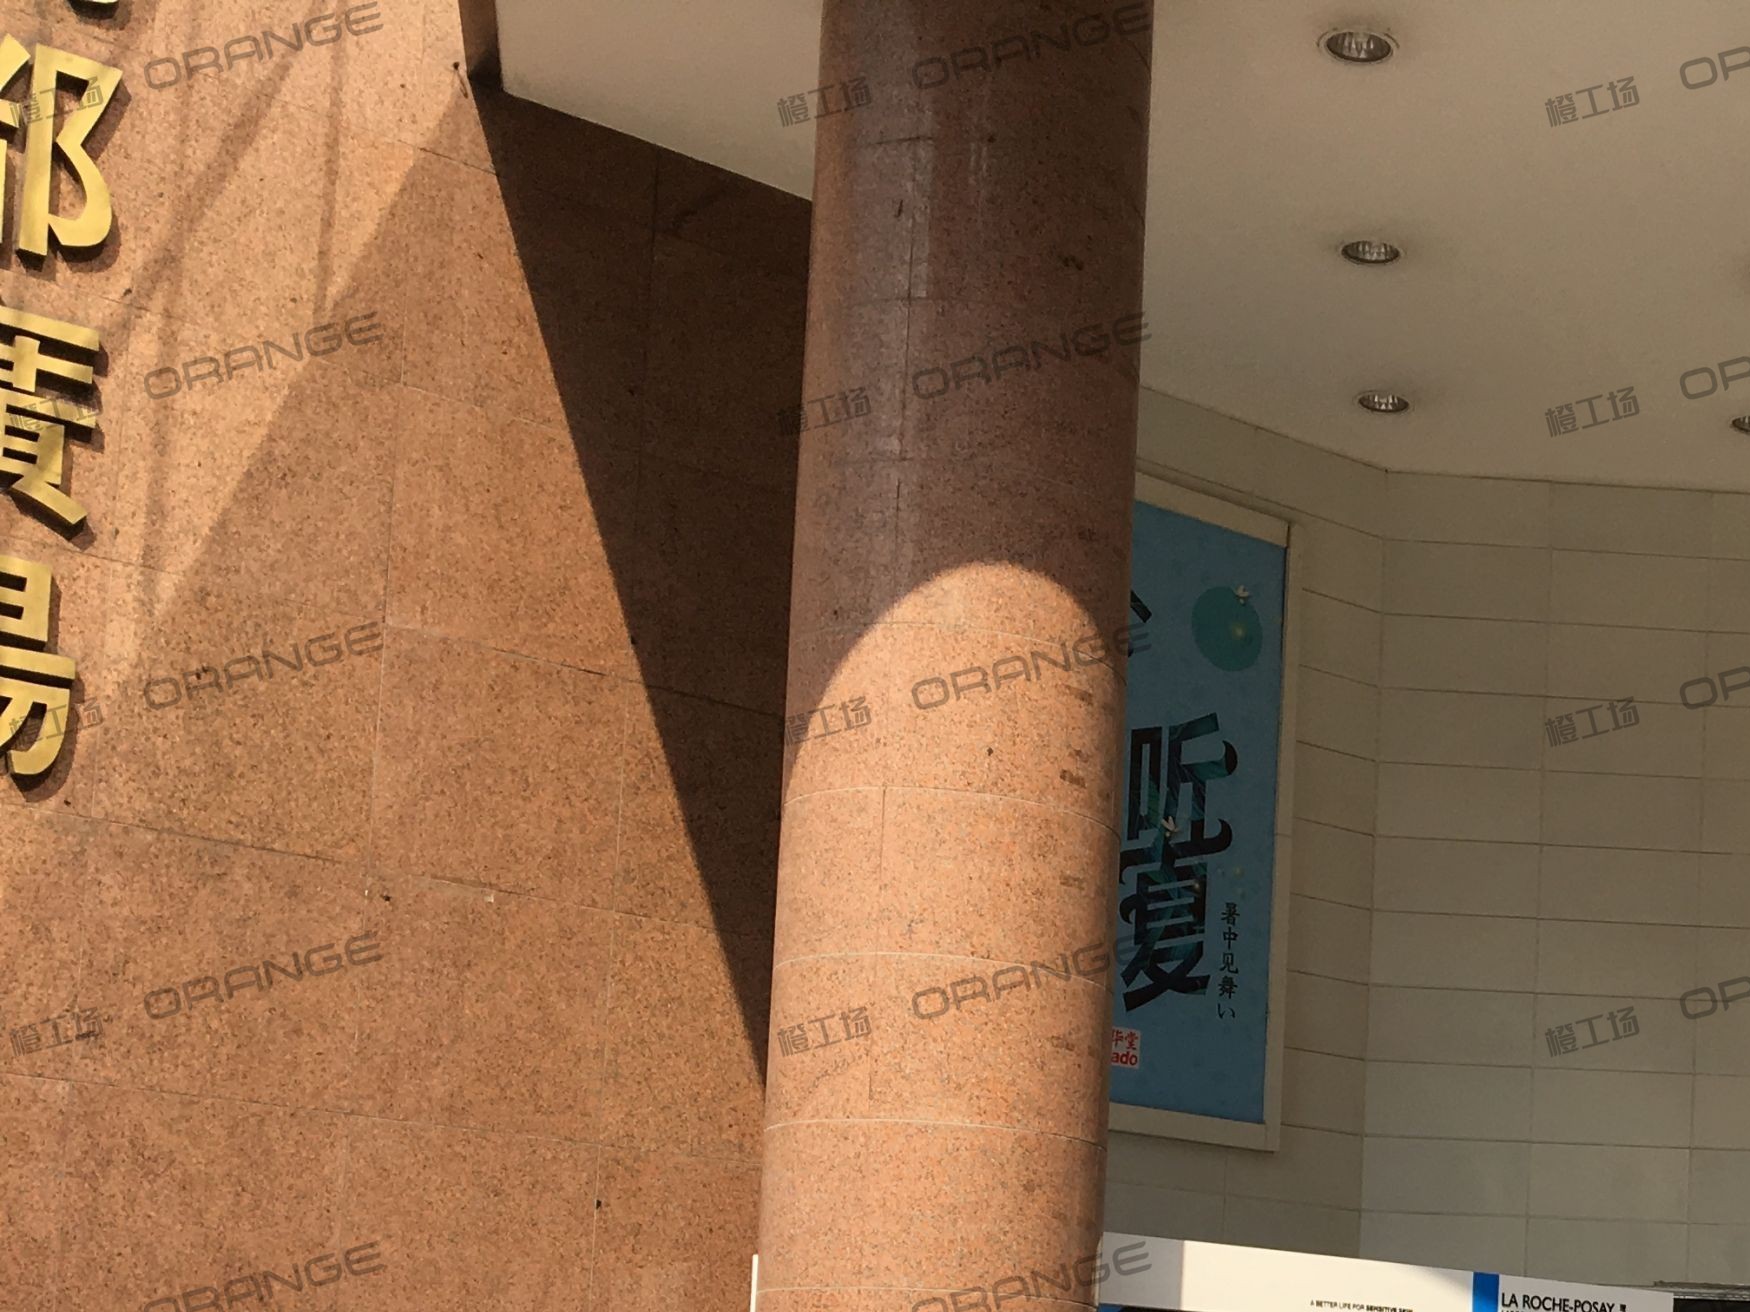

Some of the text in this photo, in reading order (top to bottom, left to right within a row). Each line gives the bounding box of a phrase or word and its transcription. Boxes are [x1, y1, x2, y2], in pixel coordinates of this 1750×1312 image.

[1316, 1300, 1337, 1308] BETTER
[1339, 1302, 1351, 1310] LIFE
[1502, 1293, 1517, 1308] LA
